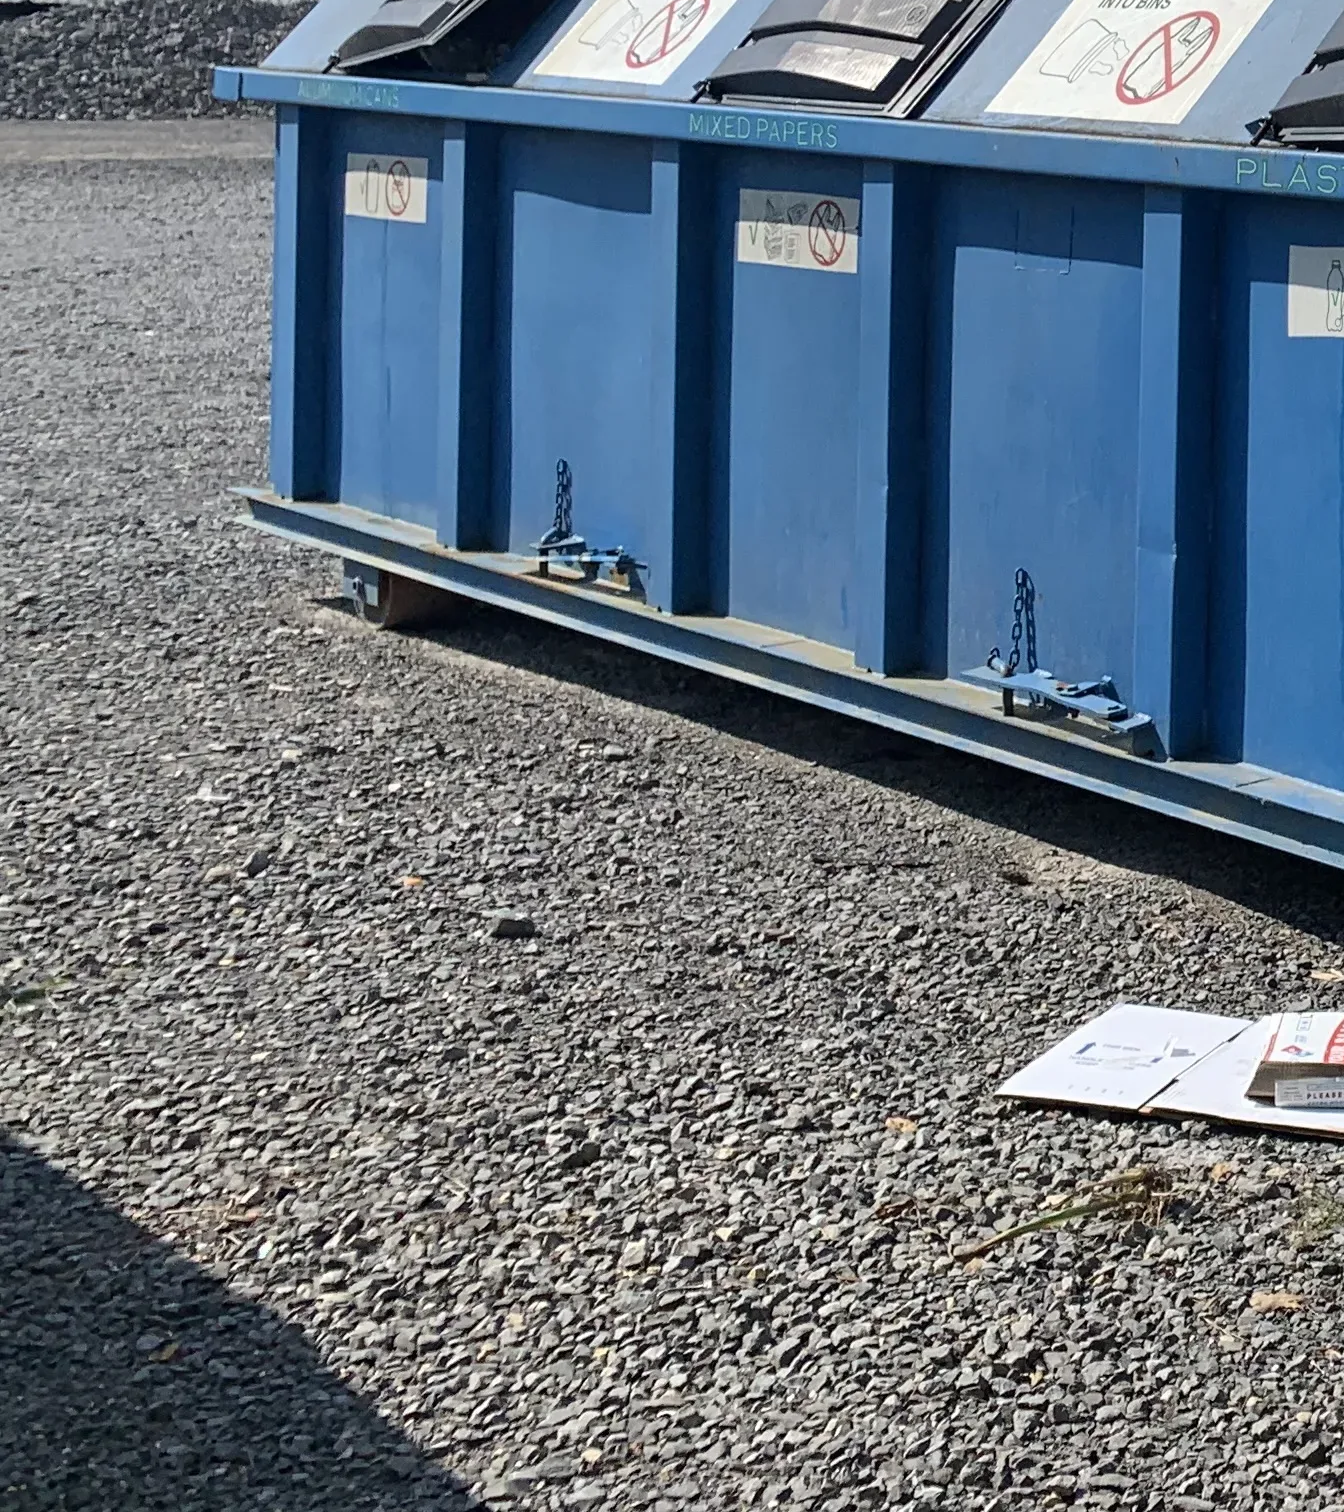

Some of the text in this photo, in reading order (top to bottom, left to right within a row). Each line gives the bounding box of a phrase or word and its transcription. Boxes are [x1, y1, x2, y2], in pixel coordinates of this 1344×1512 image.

[689, 113, 838, 148] MIXED PAPERS
[1307, 1091, 1342, 1099] PLEASE
